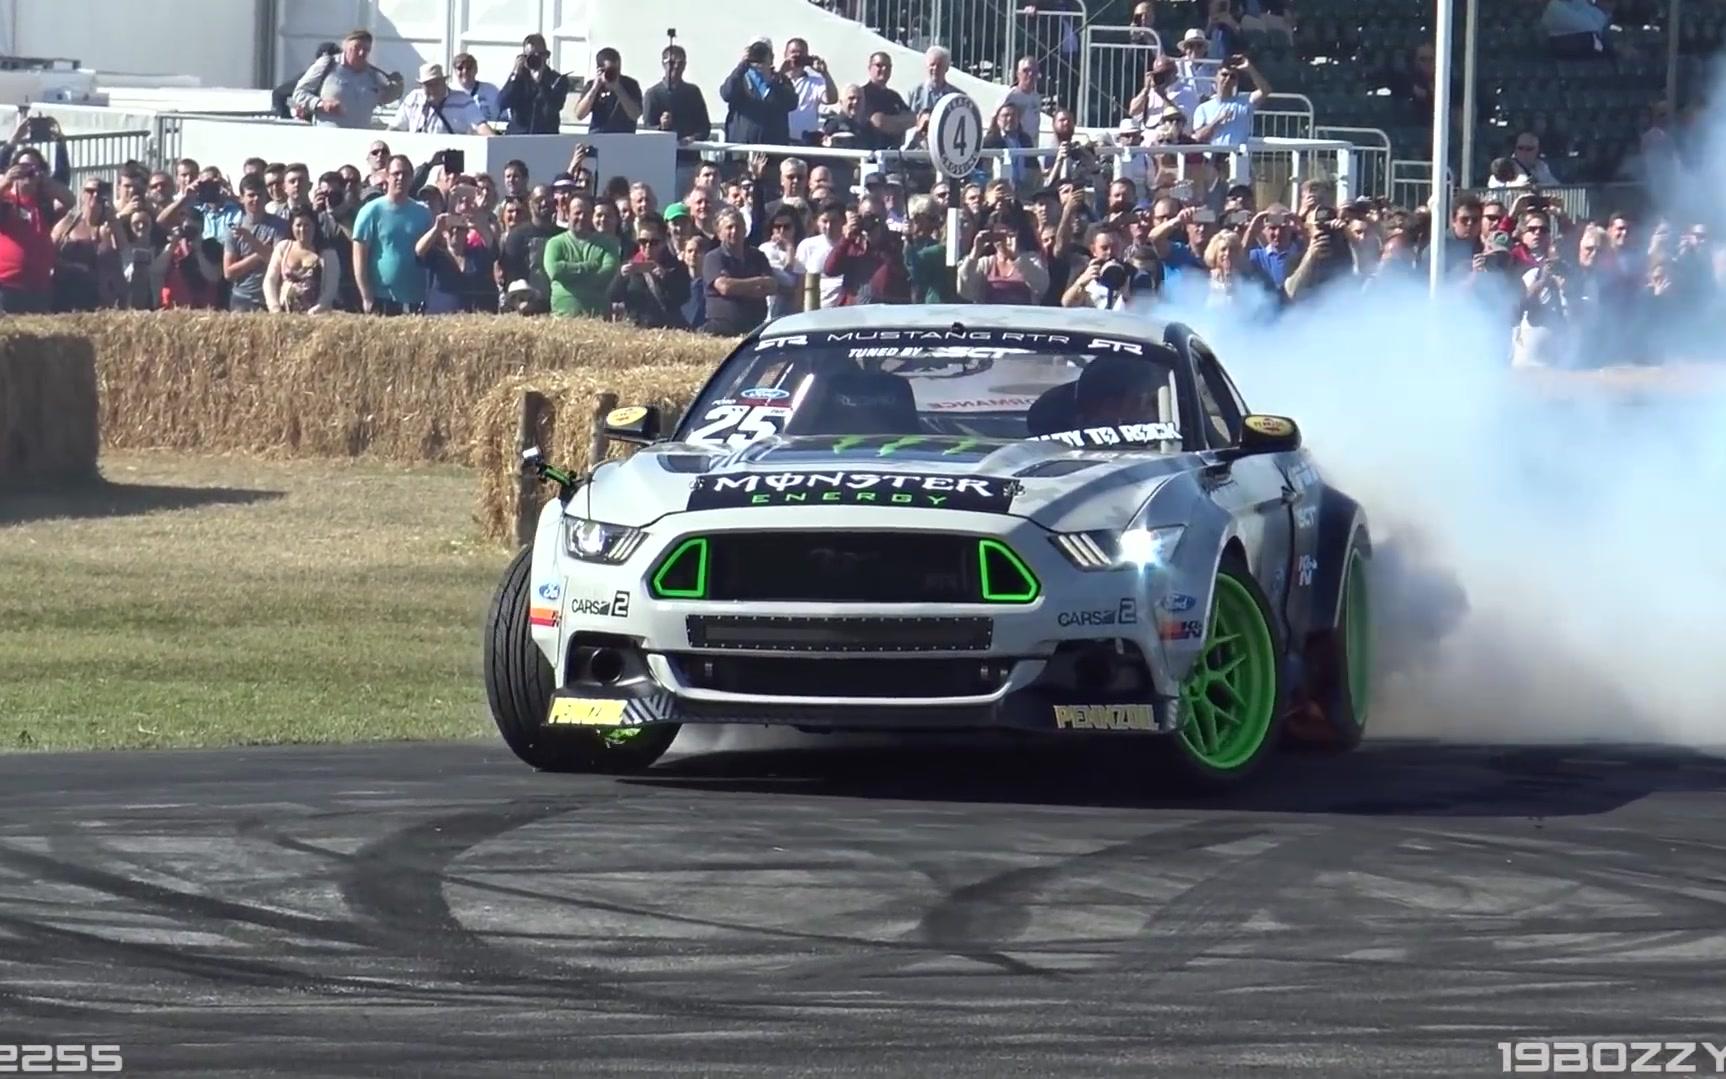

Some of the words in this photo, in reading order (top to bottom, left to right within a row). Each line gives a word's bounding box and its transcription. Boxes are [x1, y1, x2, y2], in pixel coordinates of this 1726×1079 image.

[953, 115, 967, 157] 4
[827, 331, 991, 342] MUSTANG
[1002, 331, 1070, 345] RTR
[848, 347, 899, 359] TUNED
[900, 346, 924, 358] BY
[685, 404, 793, 449] 25
[713, 471, 994, 497] MONSTER
[751, 491, 948, 505] ENERGY
[571, 598, 601, 616] CARS
[611, 590, 630, 617] 2
[1057, 610, 1102, 628] CARS
[1118, 598, 1138, 624] 2
[1053, 704, 1160, 731] PENNZOIL
